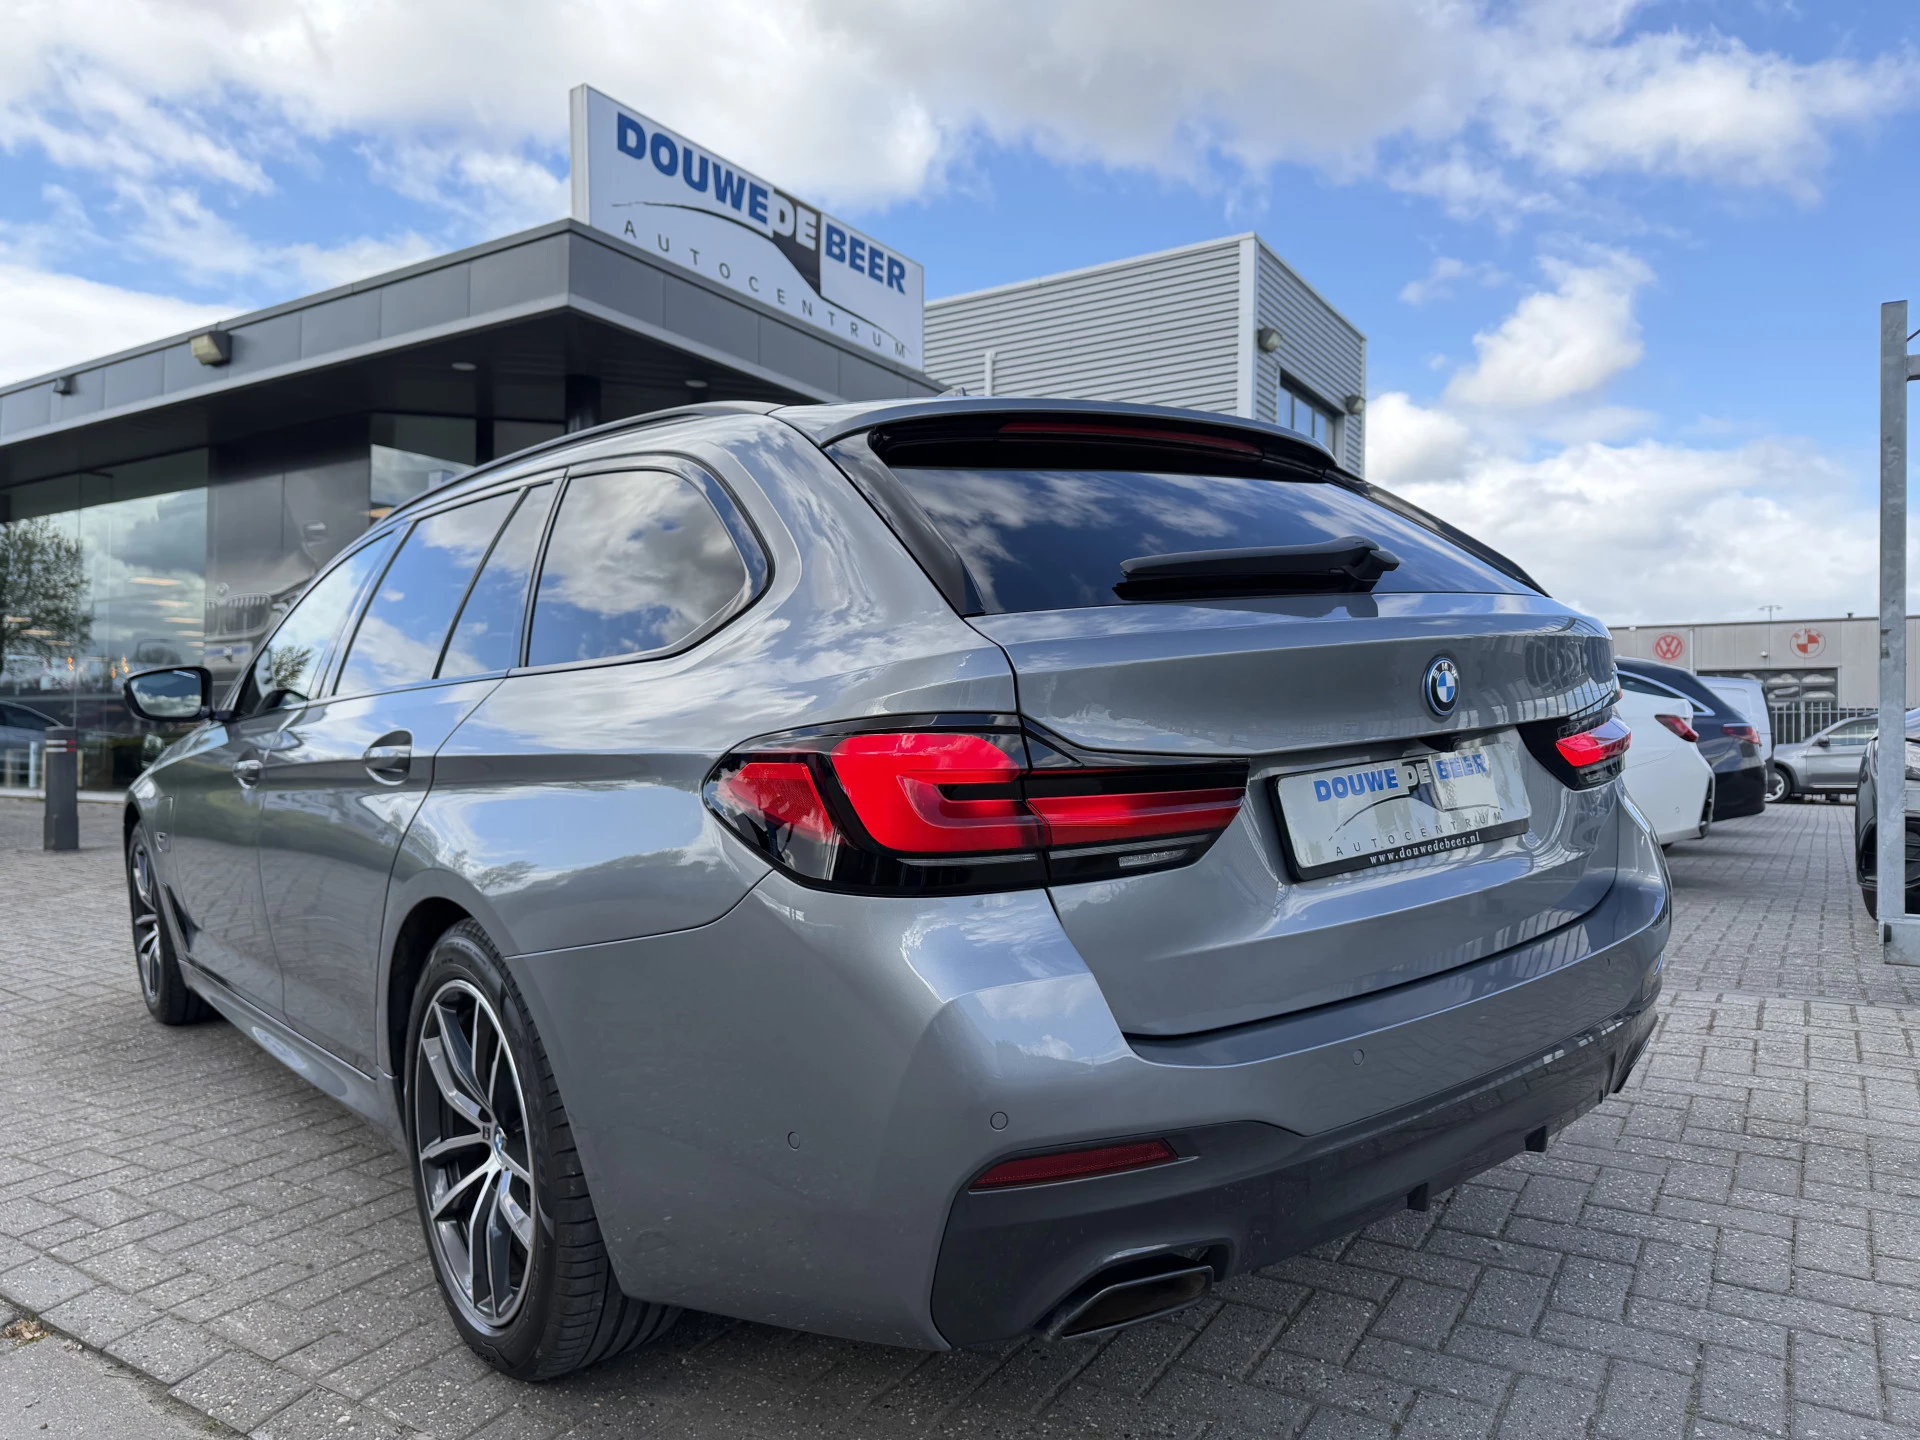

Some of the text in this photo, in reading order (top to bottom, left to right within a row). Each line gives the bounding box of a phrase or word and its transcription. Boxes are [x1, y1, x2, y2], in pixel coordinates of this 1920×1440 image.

[616, 111, 906, 295] DOUWE DE BEER
[623, 219, 906, 359] AUTOCENTRUM
[1313, 753, 1490, 802] DOUWE DE BEER
[1335, 810, 1505, 857] AUTOCENTRUM
[1369, 831, 1481, 865] www.douwedebeer.nl
